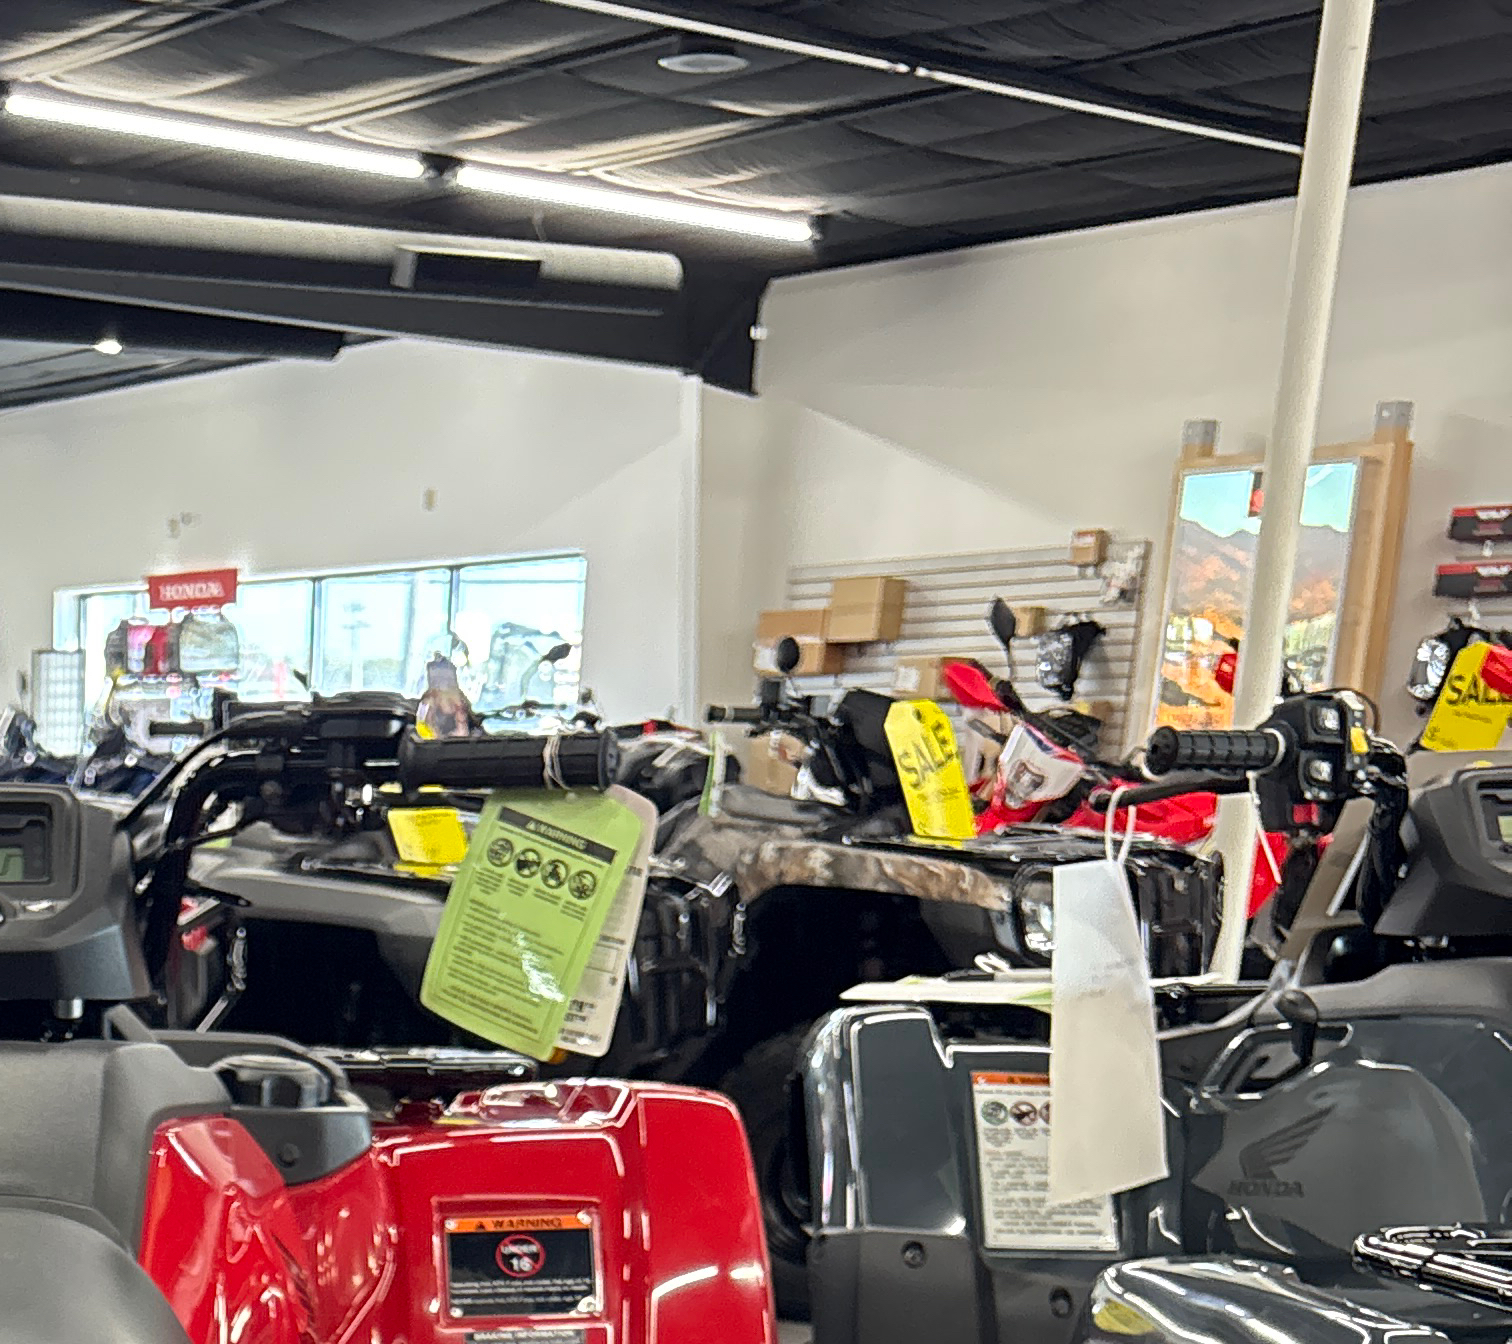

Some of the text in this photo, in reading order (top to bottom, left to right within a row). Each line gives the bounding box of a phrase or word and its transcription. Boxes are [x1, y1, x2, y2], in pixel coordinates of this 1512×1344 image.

[158, 580, 226, 602] HONDA
[1445, 671, 1512, 707] SAL
[897, 720, 955, 792] SALE
[1228, 1181, 1304, 1198] HONDA
[492, 1217, 562, 1229] WARNING
[509, 1256, 533, 1272] 16
